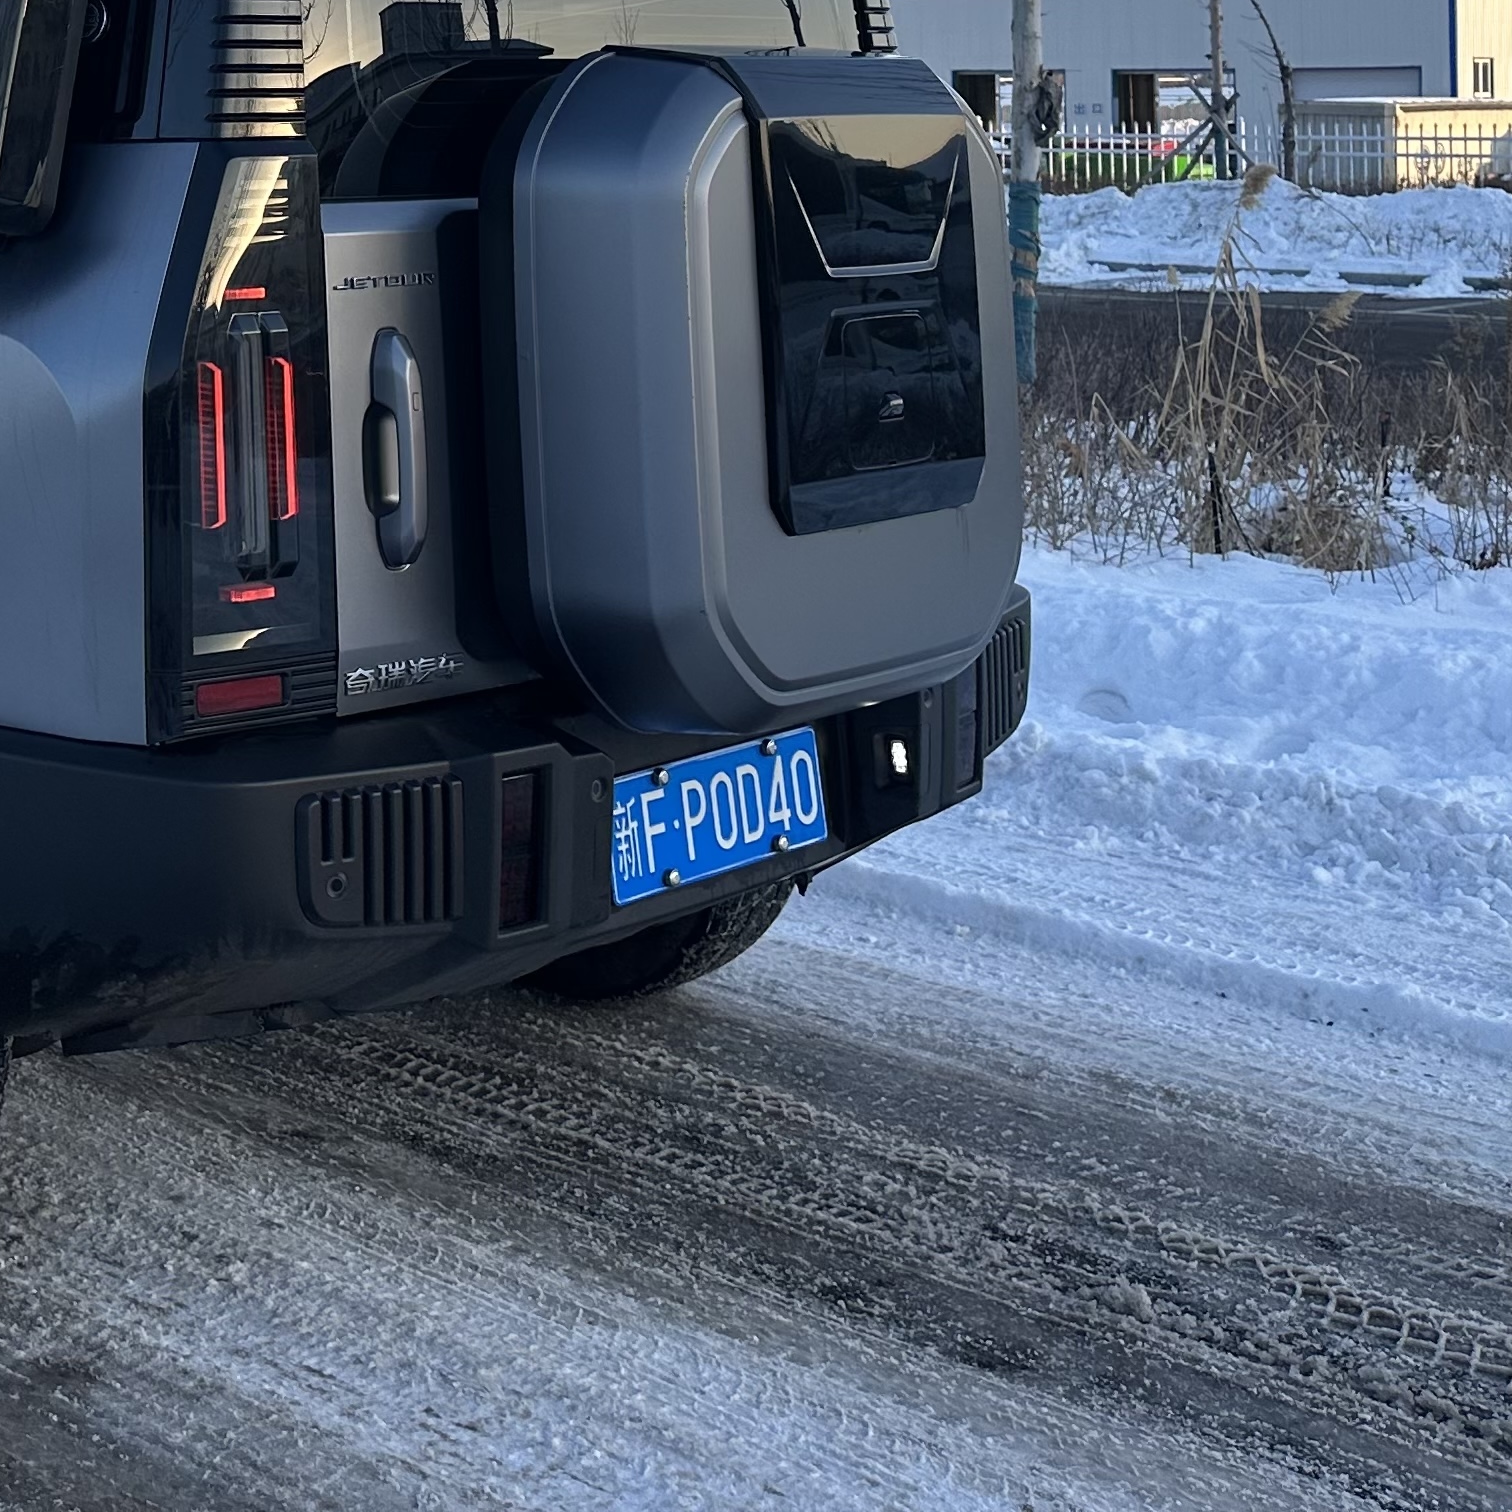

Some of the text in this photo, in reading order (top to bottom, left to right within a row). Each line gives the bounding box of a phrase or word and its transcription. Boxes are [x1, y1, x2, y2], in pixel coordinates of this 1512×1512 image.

[1074, 102, 1103, 114] 出口
[332, 272, 435, 290] JETOUR
[344, 652, 464, 695] 奇瑞汽车
